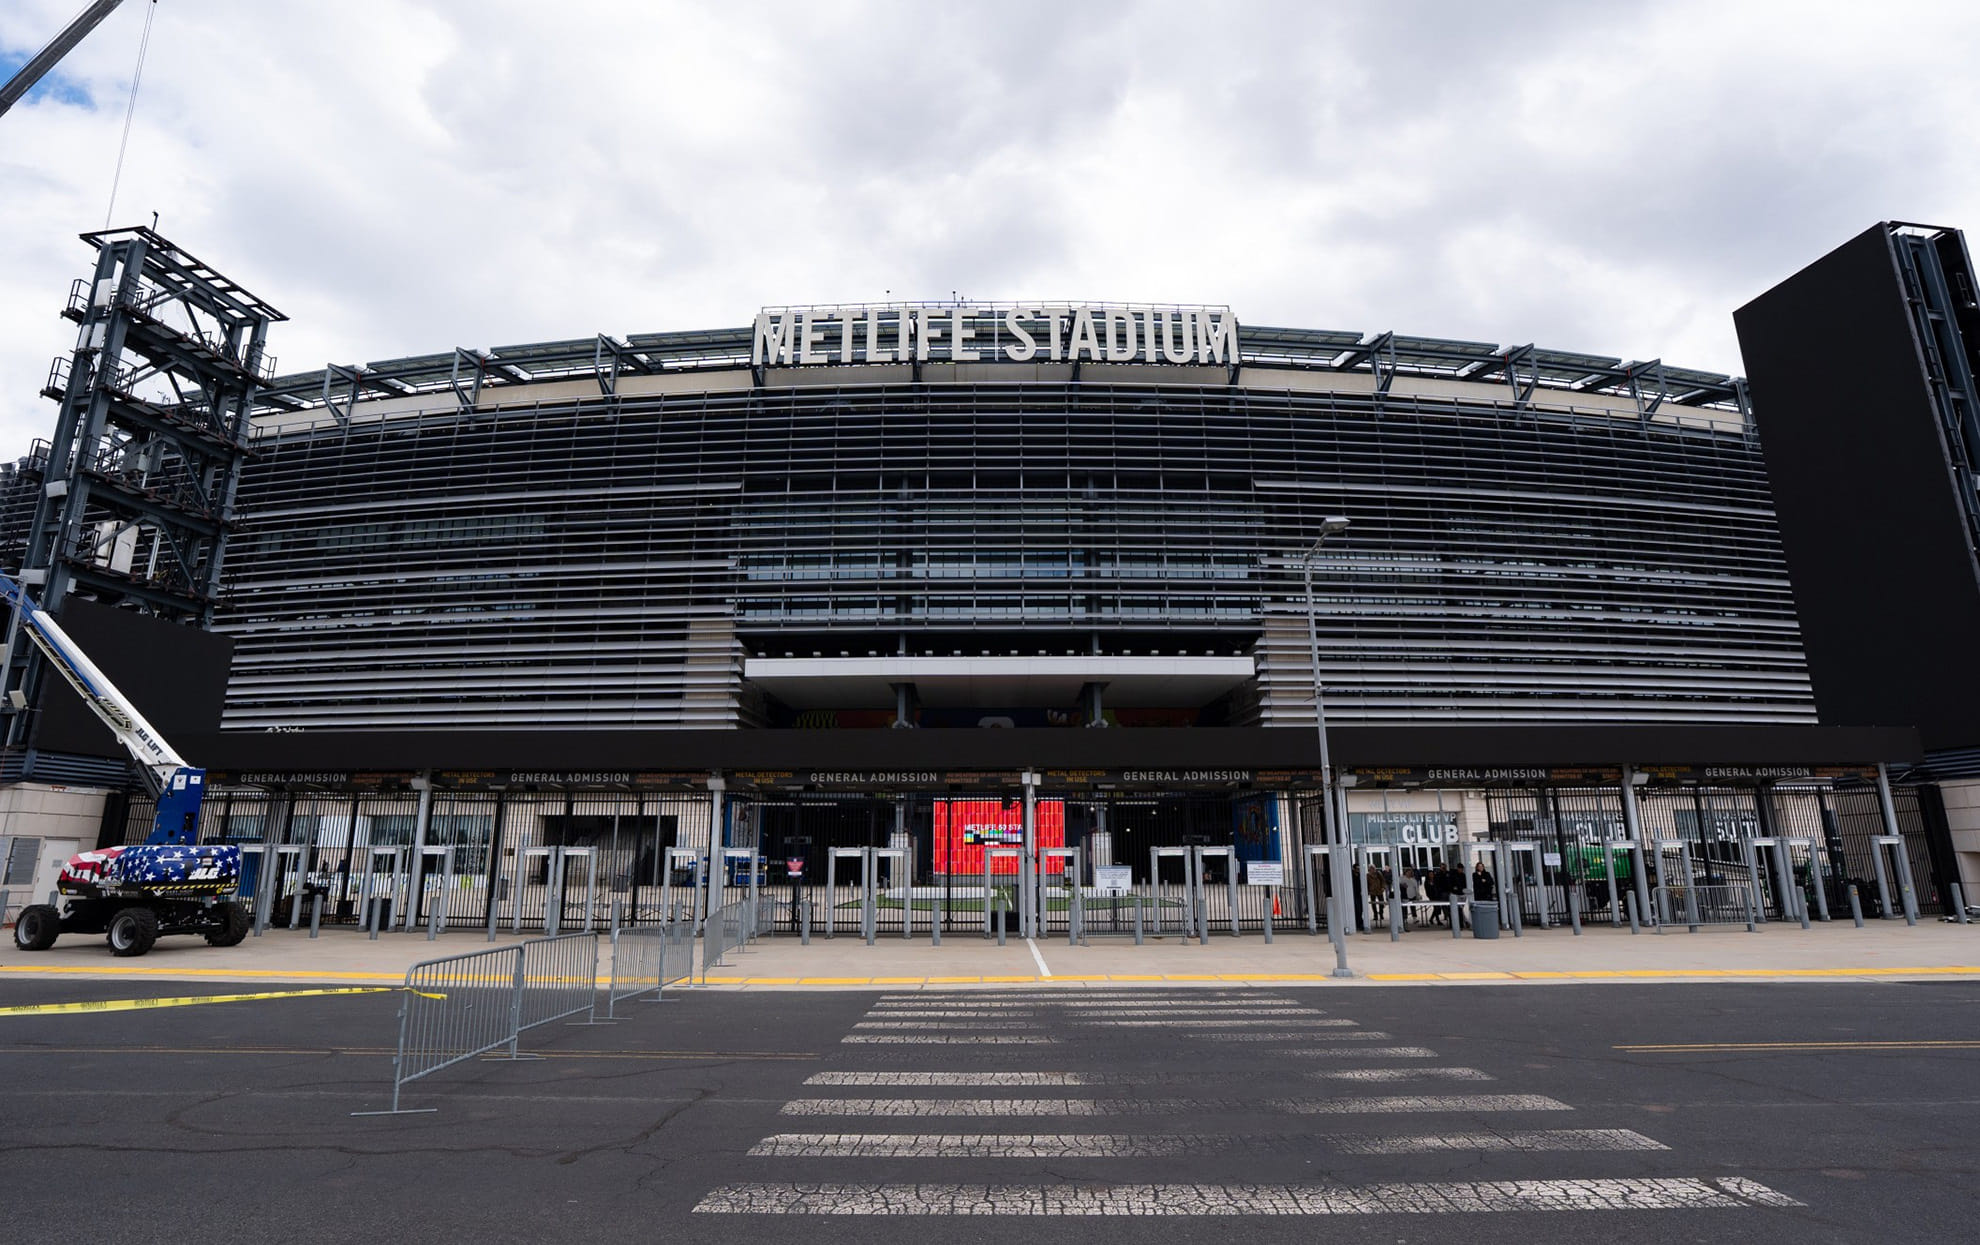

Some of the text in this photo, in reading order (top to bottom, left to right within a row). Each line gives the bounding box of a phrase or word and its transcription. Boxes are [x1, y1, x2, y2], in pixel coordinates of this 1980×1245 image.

[753, 307, 1239, 365] METLIFE STADIUM
[135, 727, 164, 756] JLG LIFT
[811, 773, 865, 782] GENERAL
[870, 773, 937, 782] ADMISSION
[1123, 771, 1178, 781] GENERAL
[1184, 771, 1249, 780] ADMISSION
[1428, 769, 1480, 779] GENERAL
[1485, 769, 1546, 778] ADMISSION
[1705, 768, 1752, 777] GENERAL
[1755, 768, 1811, 776] ADMISSION
[241, 774, 286, 783] GENERAL
[290, 774, 347, 782] ADMISSION
[511, 773, 562, 783] GENERAL
[567, 773, 629, 782] ADMISSION
[1368, 813, 1407, 823] MILLER
[1410, 813, 1432, 823] LITE
[1402, 824, 1459, 843] CLUB
[188, 867, 221, 880] JLG
